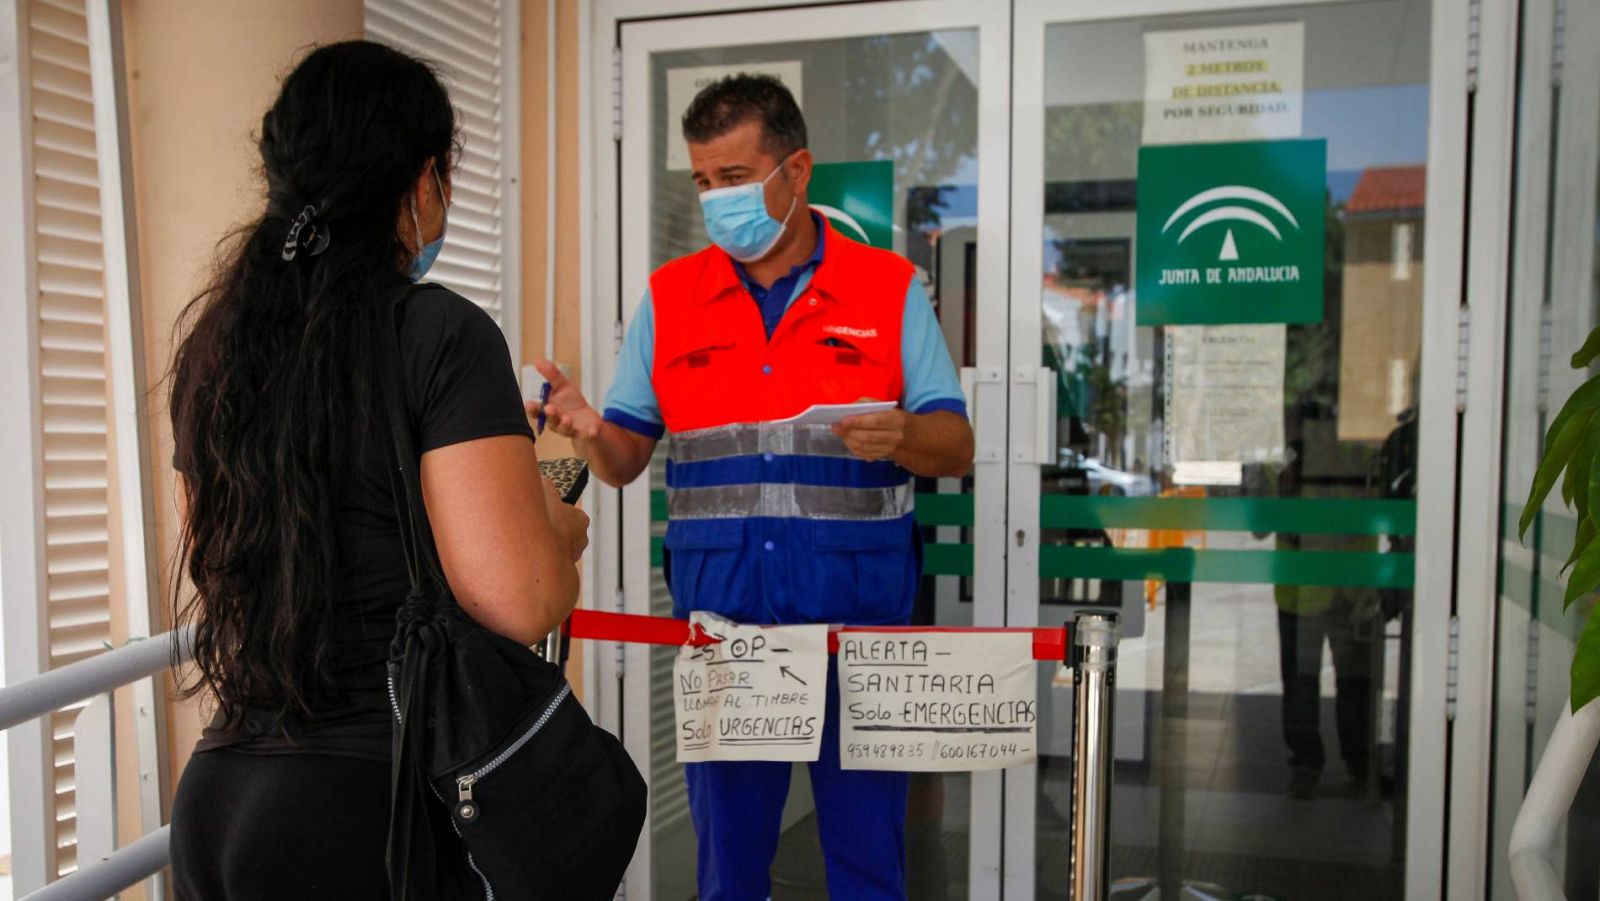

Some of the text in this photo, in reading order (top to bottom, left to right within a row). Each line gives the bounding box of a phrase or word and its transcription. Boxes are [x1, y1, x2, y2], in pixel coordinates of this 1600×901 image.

[1183, 37, 1269, 53] MANTENGA
[1187, 60, 1264, 76] 2 METROS
[1173, 86, 1191, 98] DE
[1164, 106, 1193, 119] POR
[1159, 268, 1200, 286] JUNTA
[1206, 267, 1222, 284] DE
[844, 639, 928, 662] ALERTA
[848, 673, 995, 694] SANITARIA
[724, 693, 742, 709] AL
[751, 693, 809, 708] TIMBRE
[903, 700, 1036, 726] EMERGENCIAS
[719, 716, 817, 737] URGENCIAS
